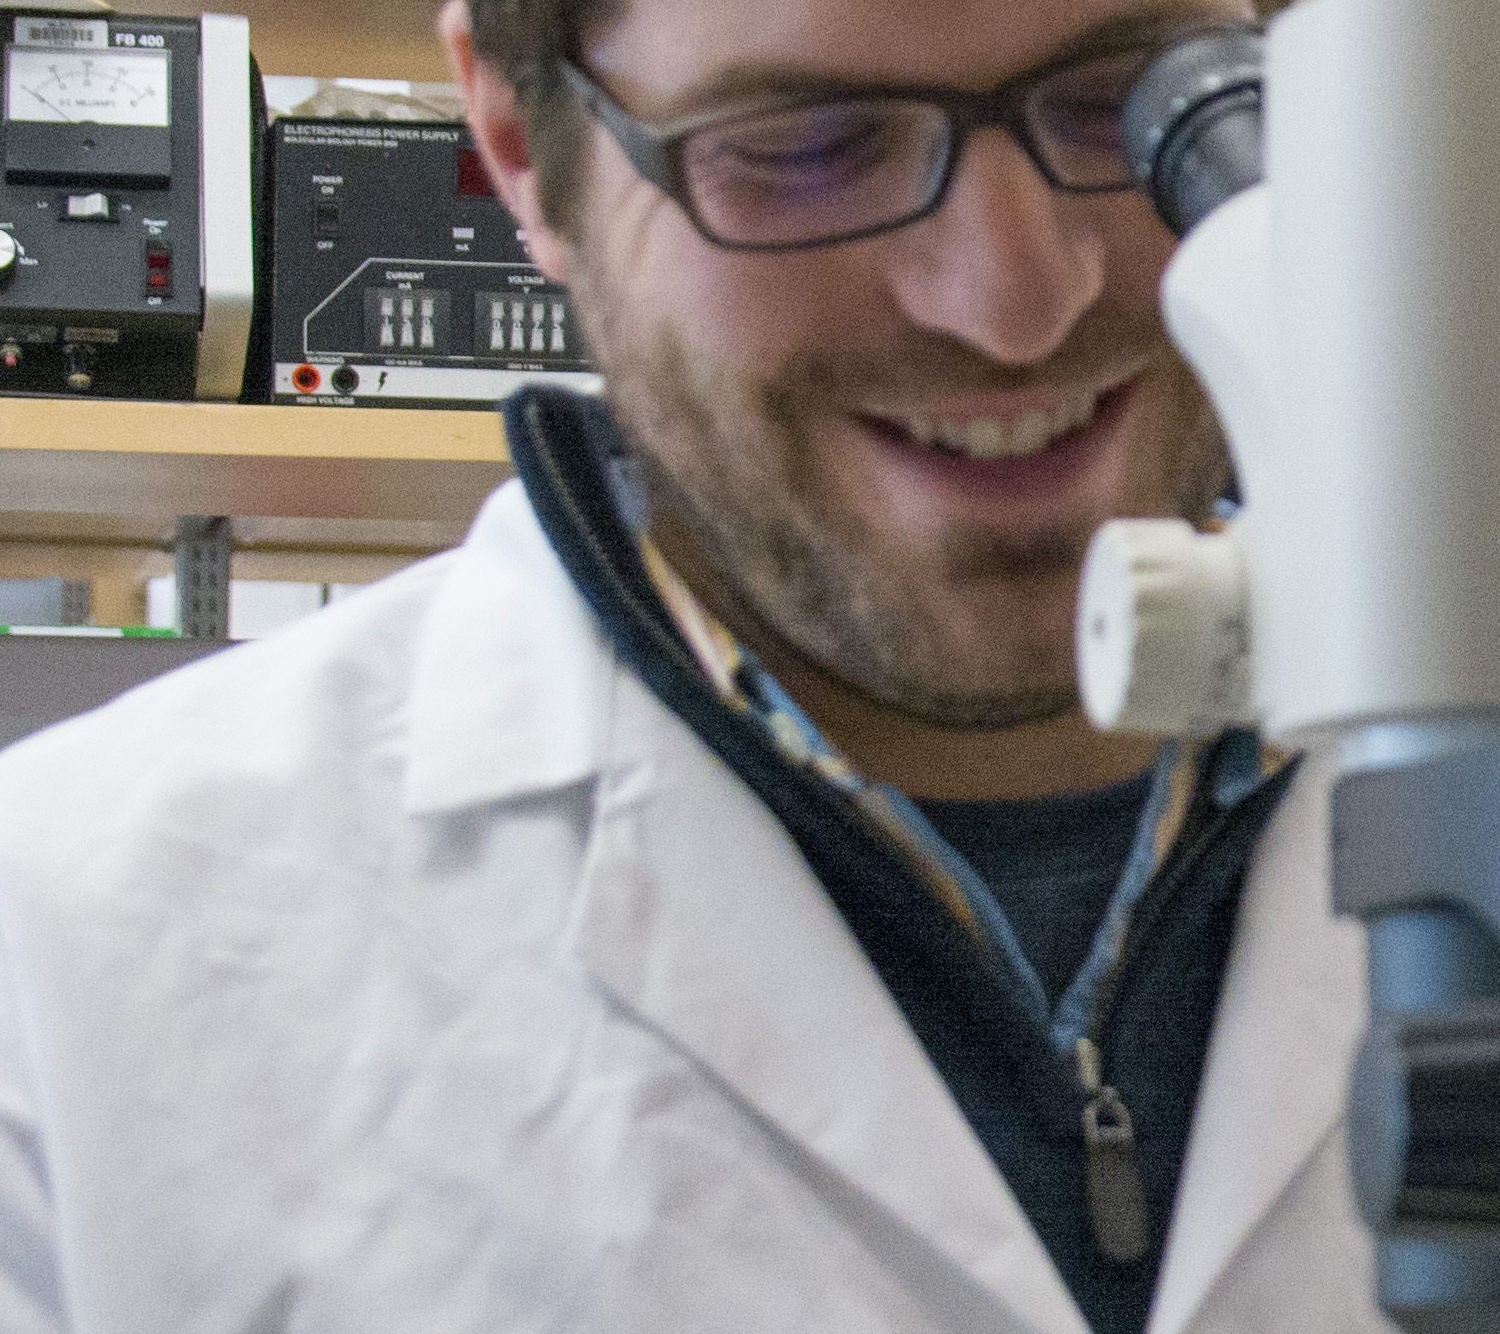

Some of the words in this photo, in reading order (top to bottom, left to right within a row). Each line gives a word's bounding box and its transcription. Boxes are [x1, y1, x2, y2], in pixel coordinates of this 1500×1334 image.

[115, 33, 136, 46] FB
[138, 34, 165, 48] 400
[284, 124, 382, 139] ELECTROPHORESIS
[383, 127, 420, 141] POWER
[421, 129, 459, 142] SUPPLY
[312, 174, 344, 186] POWER
[320, 185, 335, 196] ON
[316, 241, 335, 250] OFF
[385, 270, 425, 281] CURRENT
[507, 275, 546, 285] VOLTAGE
